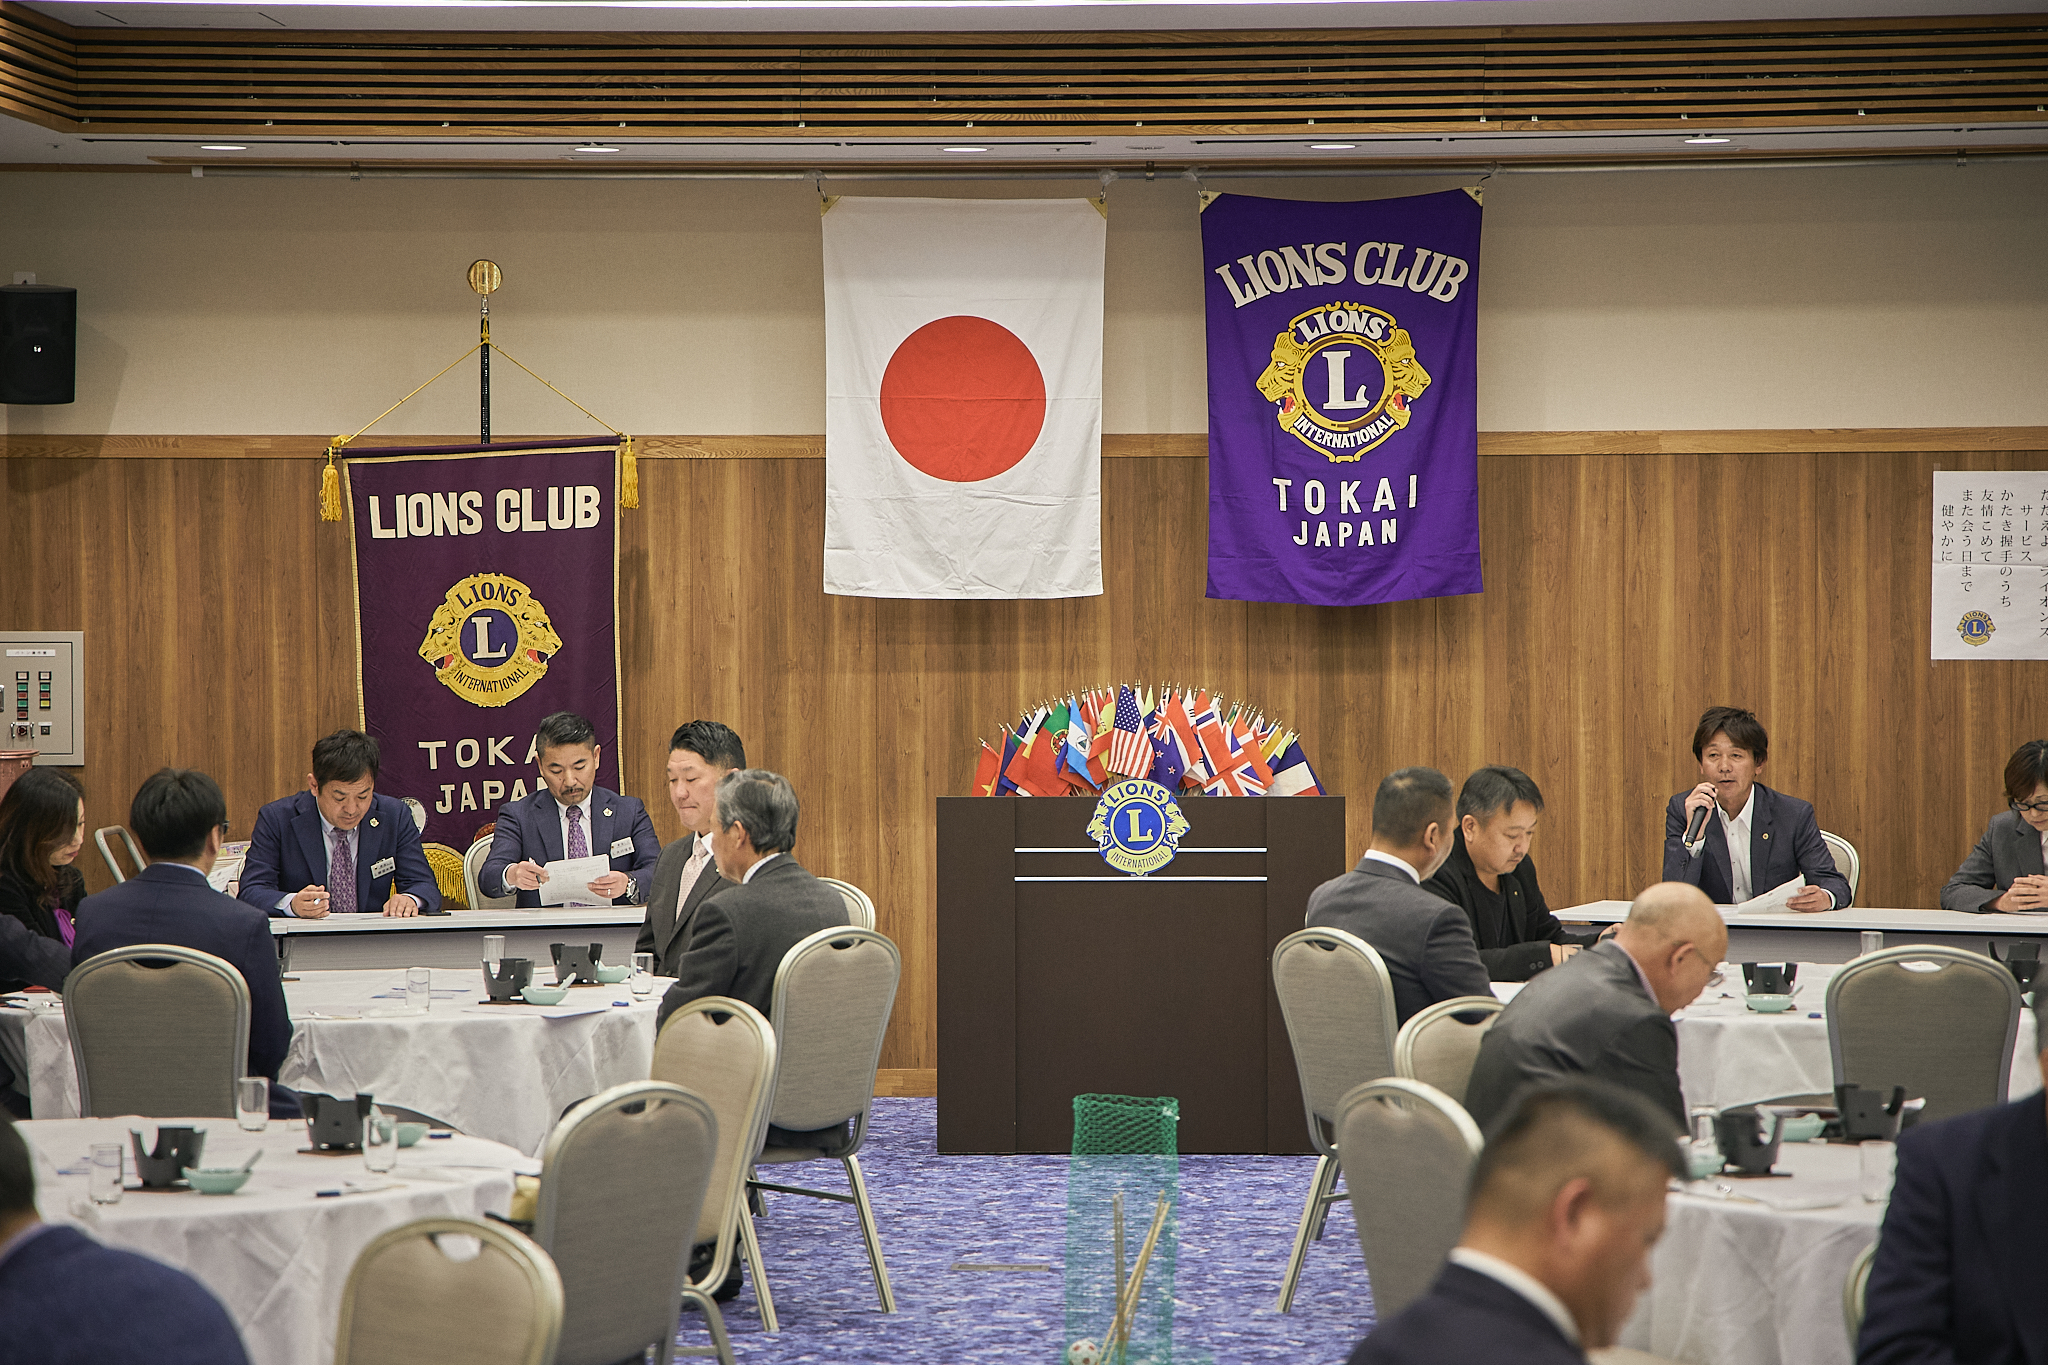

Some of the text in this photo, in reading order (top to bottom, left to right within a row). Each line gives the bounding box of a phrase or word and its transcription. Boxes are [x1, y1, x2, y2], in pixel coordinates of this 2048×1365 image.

[1215, 241, 1470, 308] LIONS CLUB
[1297, 309, 1389, 343] LIONS
[1322, 350, 1370, 410] L
[1294, 414, 1395, 449] INTERNATIONAL
[368, 485, 601, 539] LIONS CLUB
[1272, 474, 1418, 515] TOKAI
[1292, 518, 1398, 548] JAPAN
[1941, 504, 1954, 562] 健やかに
[1961, 489, 1974, 592] また会う日まで
[1981, 489, 1994, 562] 友情こめて
[2020, 504, 2033, 562] サービス
[2000, 489, 2014, 608] かたき握手のうち
[455, 582, 522, 609] LIONS
[1965, 611, 1987, 620] LIONS
[1971, 621, 1982, 634] L
[471, 616, 507, 660] L
[453, 668, 529, 693] INTERNATIONAL
[1107, 783, 1165, 804] LIONS
[1126, 808, 1154, 842] L
[1110, 850, 1169, 868] INTERNATIONAL
